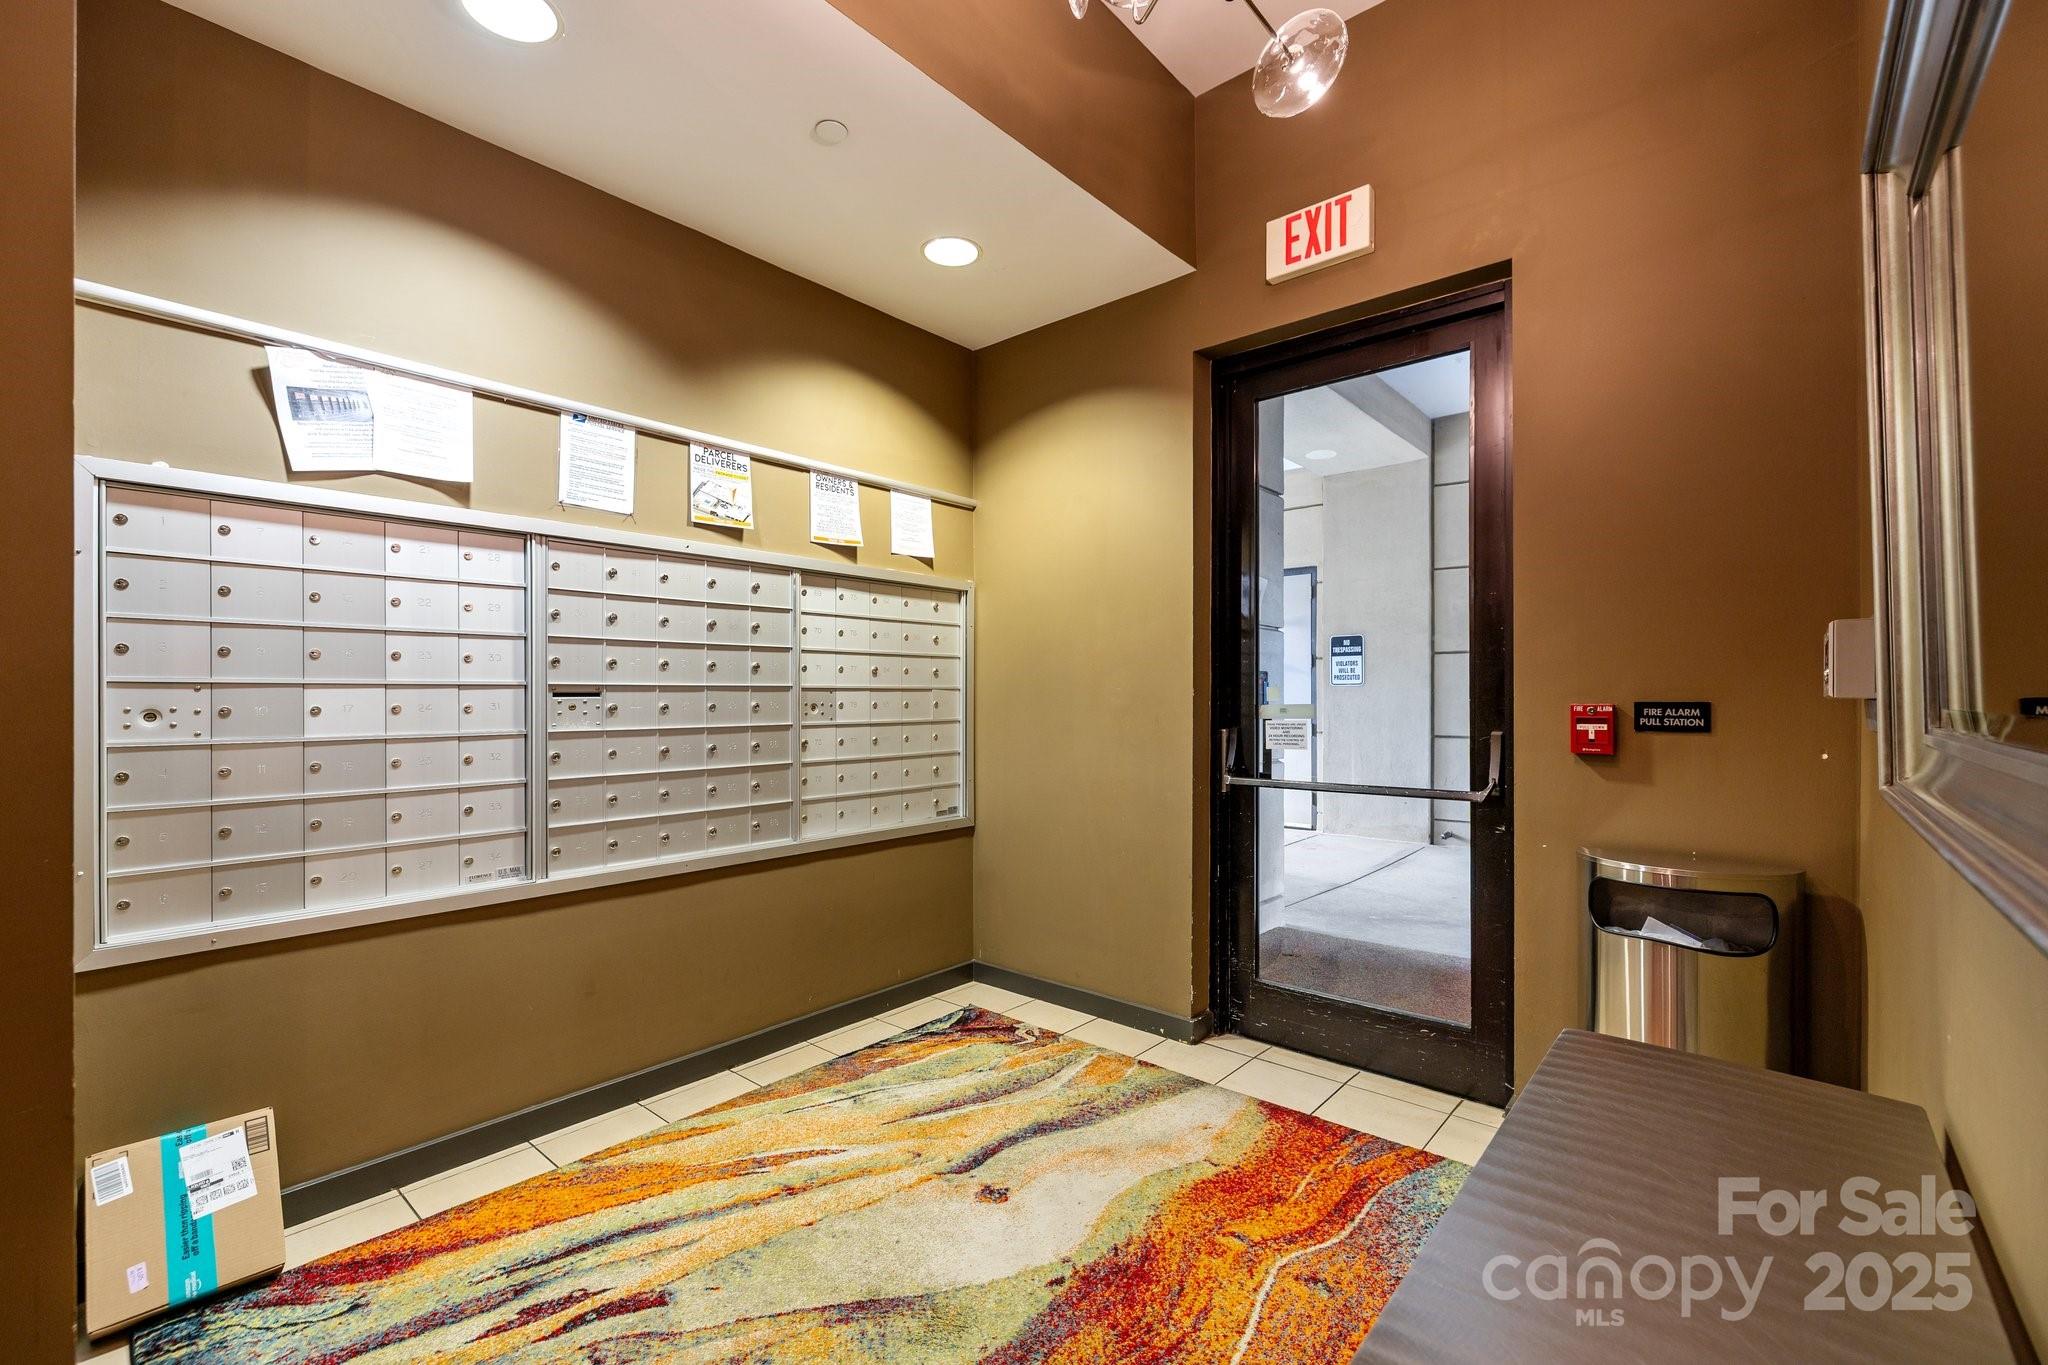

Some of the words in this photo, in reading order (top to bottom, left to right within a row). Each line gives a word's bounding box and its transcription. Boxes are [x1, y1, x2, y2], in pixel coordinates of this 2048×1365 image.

[1285, 194, 1352, 266] EXIT
[703, 447, 737, 462] PARCEL
[694, 453, 748, 472] DELIVERERS
[815, 473, 847, 487] OWNERS
[848, 480, 854, 488] &
[815, 481, 855, 496] RESIDENTS
[1643, 708, 1663, 716] FIRE
[1665, 708, 1701, 717] ALARM
[1639, 718, 1661, 726] PULL
[1663, 718, 1705, 727] STATION
[179, 1193, 188, 1219] ripping
[181, 1236, 190, 1261] Easier
